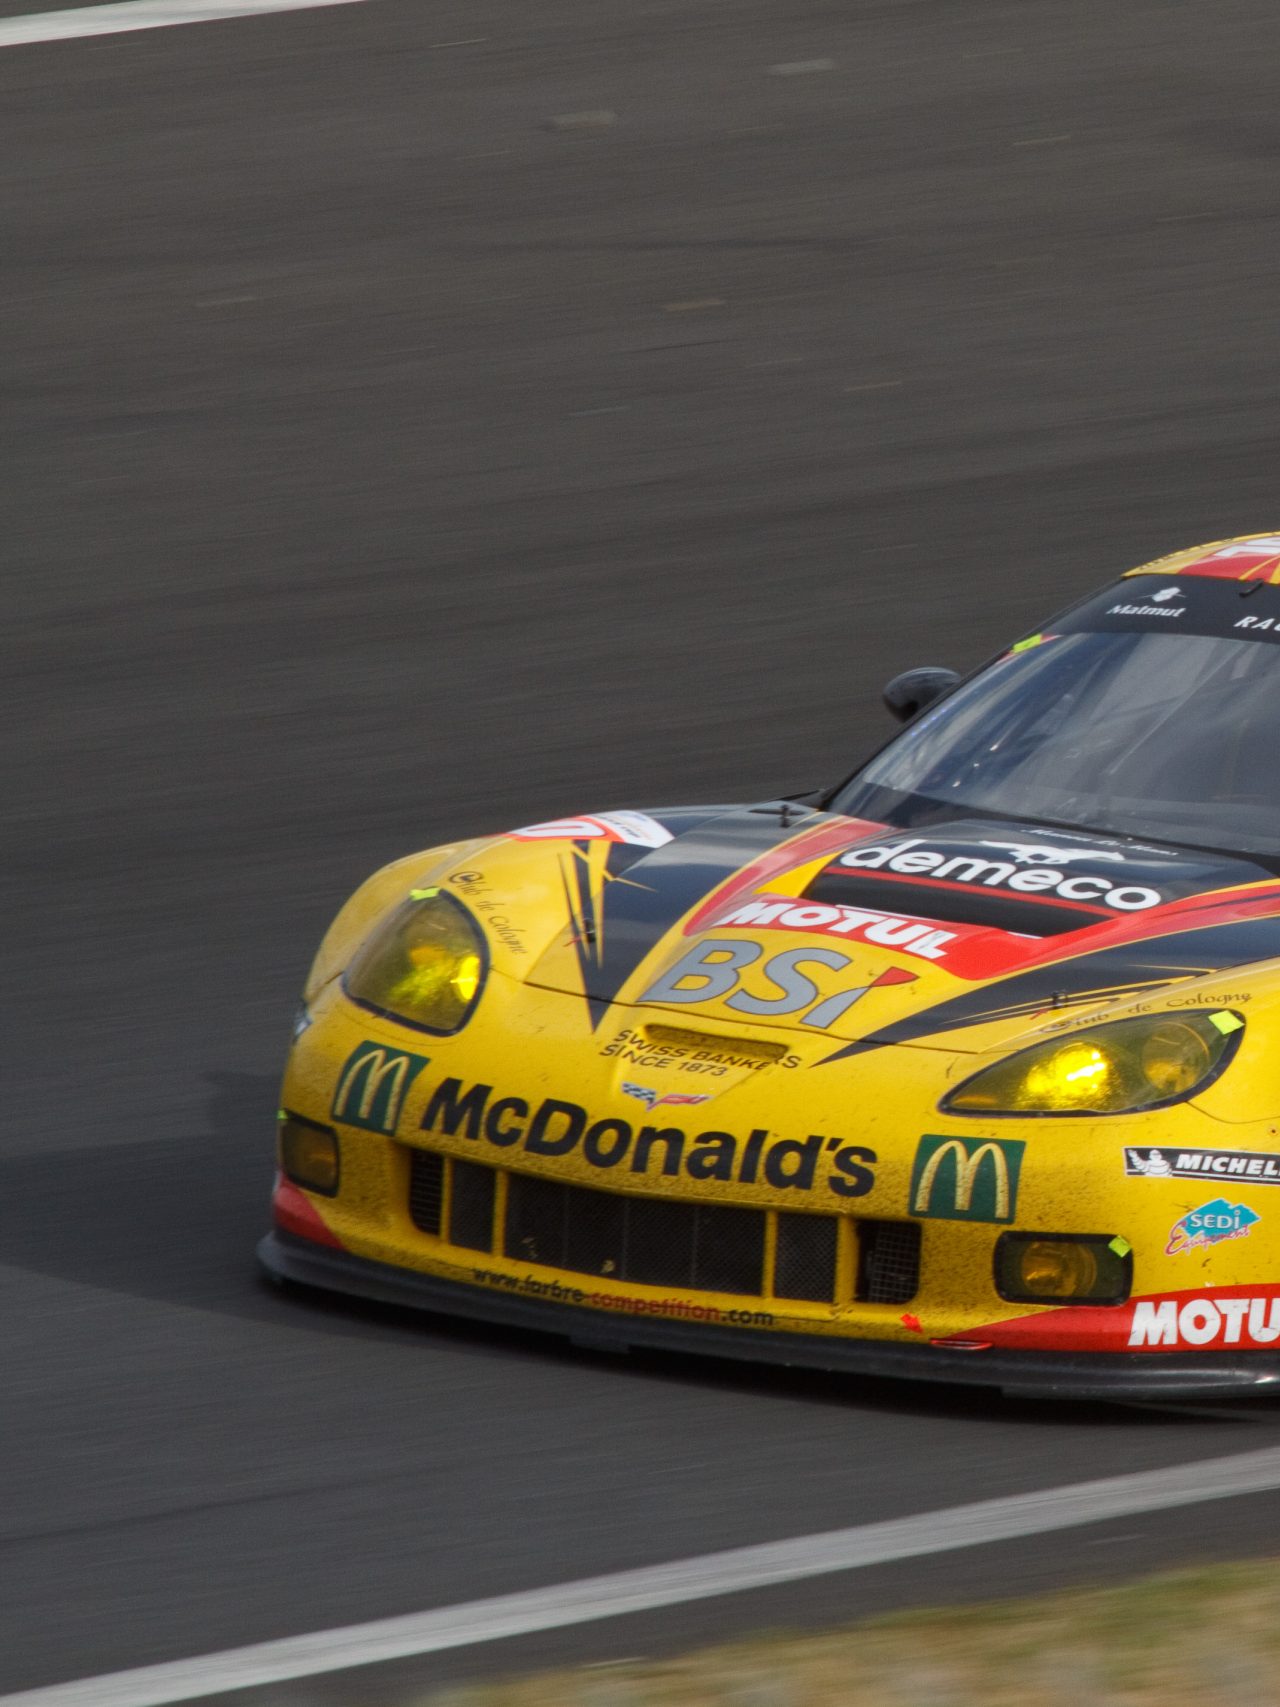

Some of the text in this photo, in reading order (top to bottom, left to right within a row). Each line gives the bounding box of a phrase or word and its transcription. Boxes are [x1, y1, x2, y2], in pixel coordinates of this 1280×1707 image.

[1106, 604, 1187, 618] Matmut
[838, 840, 1162, 911] demeco
[713, 901, 961, 959] MOTUL
[599, 1043, 729, 1077] SINCE 1873
[613, 1029, 689, 1060] SWISS
[420, 1078, 879, 1198] McDonald's
